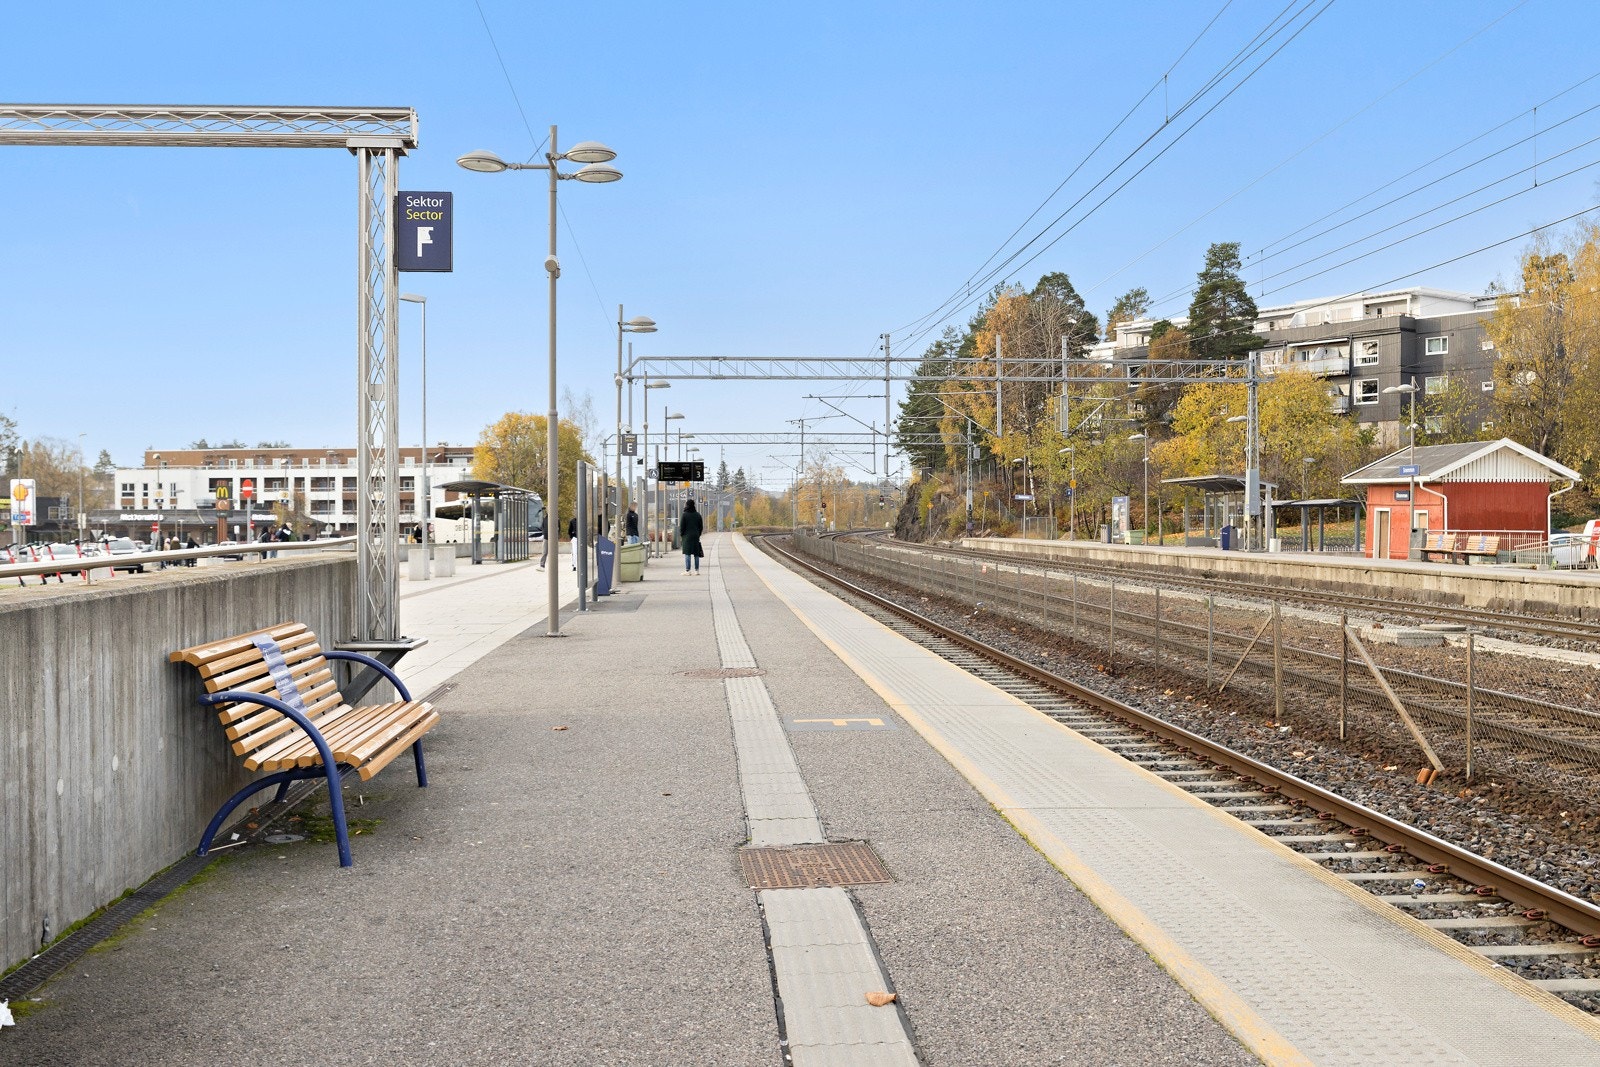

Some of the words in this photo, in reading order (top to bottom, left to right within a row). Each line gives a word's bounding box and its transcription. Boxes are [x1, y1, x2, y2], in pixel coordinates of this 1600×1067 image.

[406, 195, 444, 207] Sektor
[406, 208, 444, 220] Sector
[417, 226, 434, 257] F
[627, 442, 633, 453] E
[696, 470, 701, 479] 3
